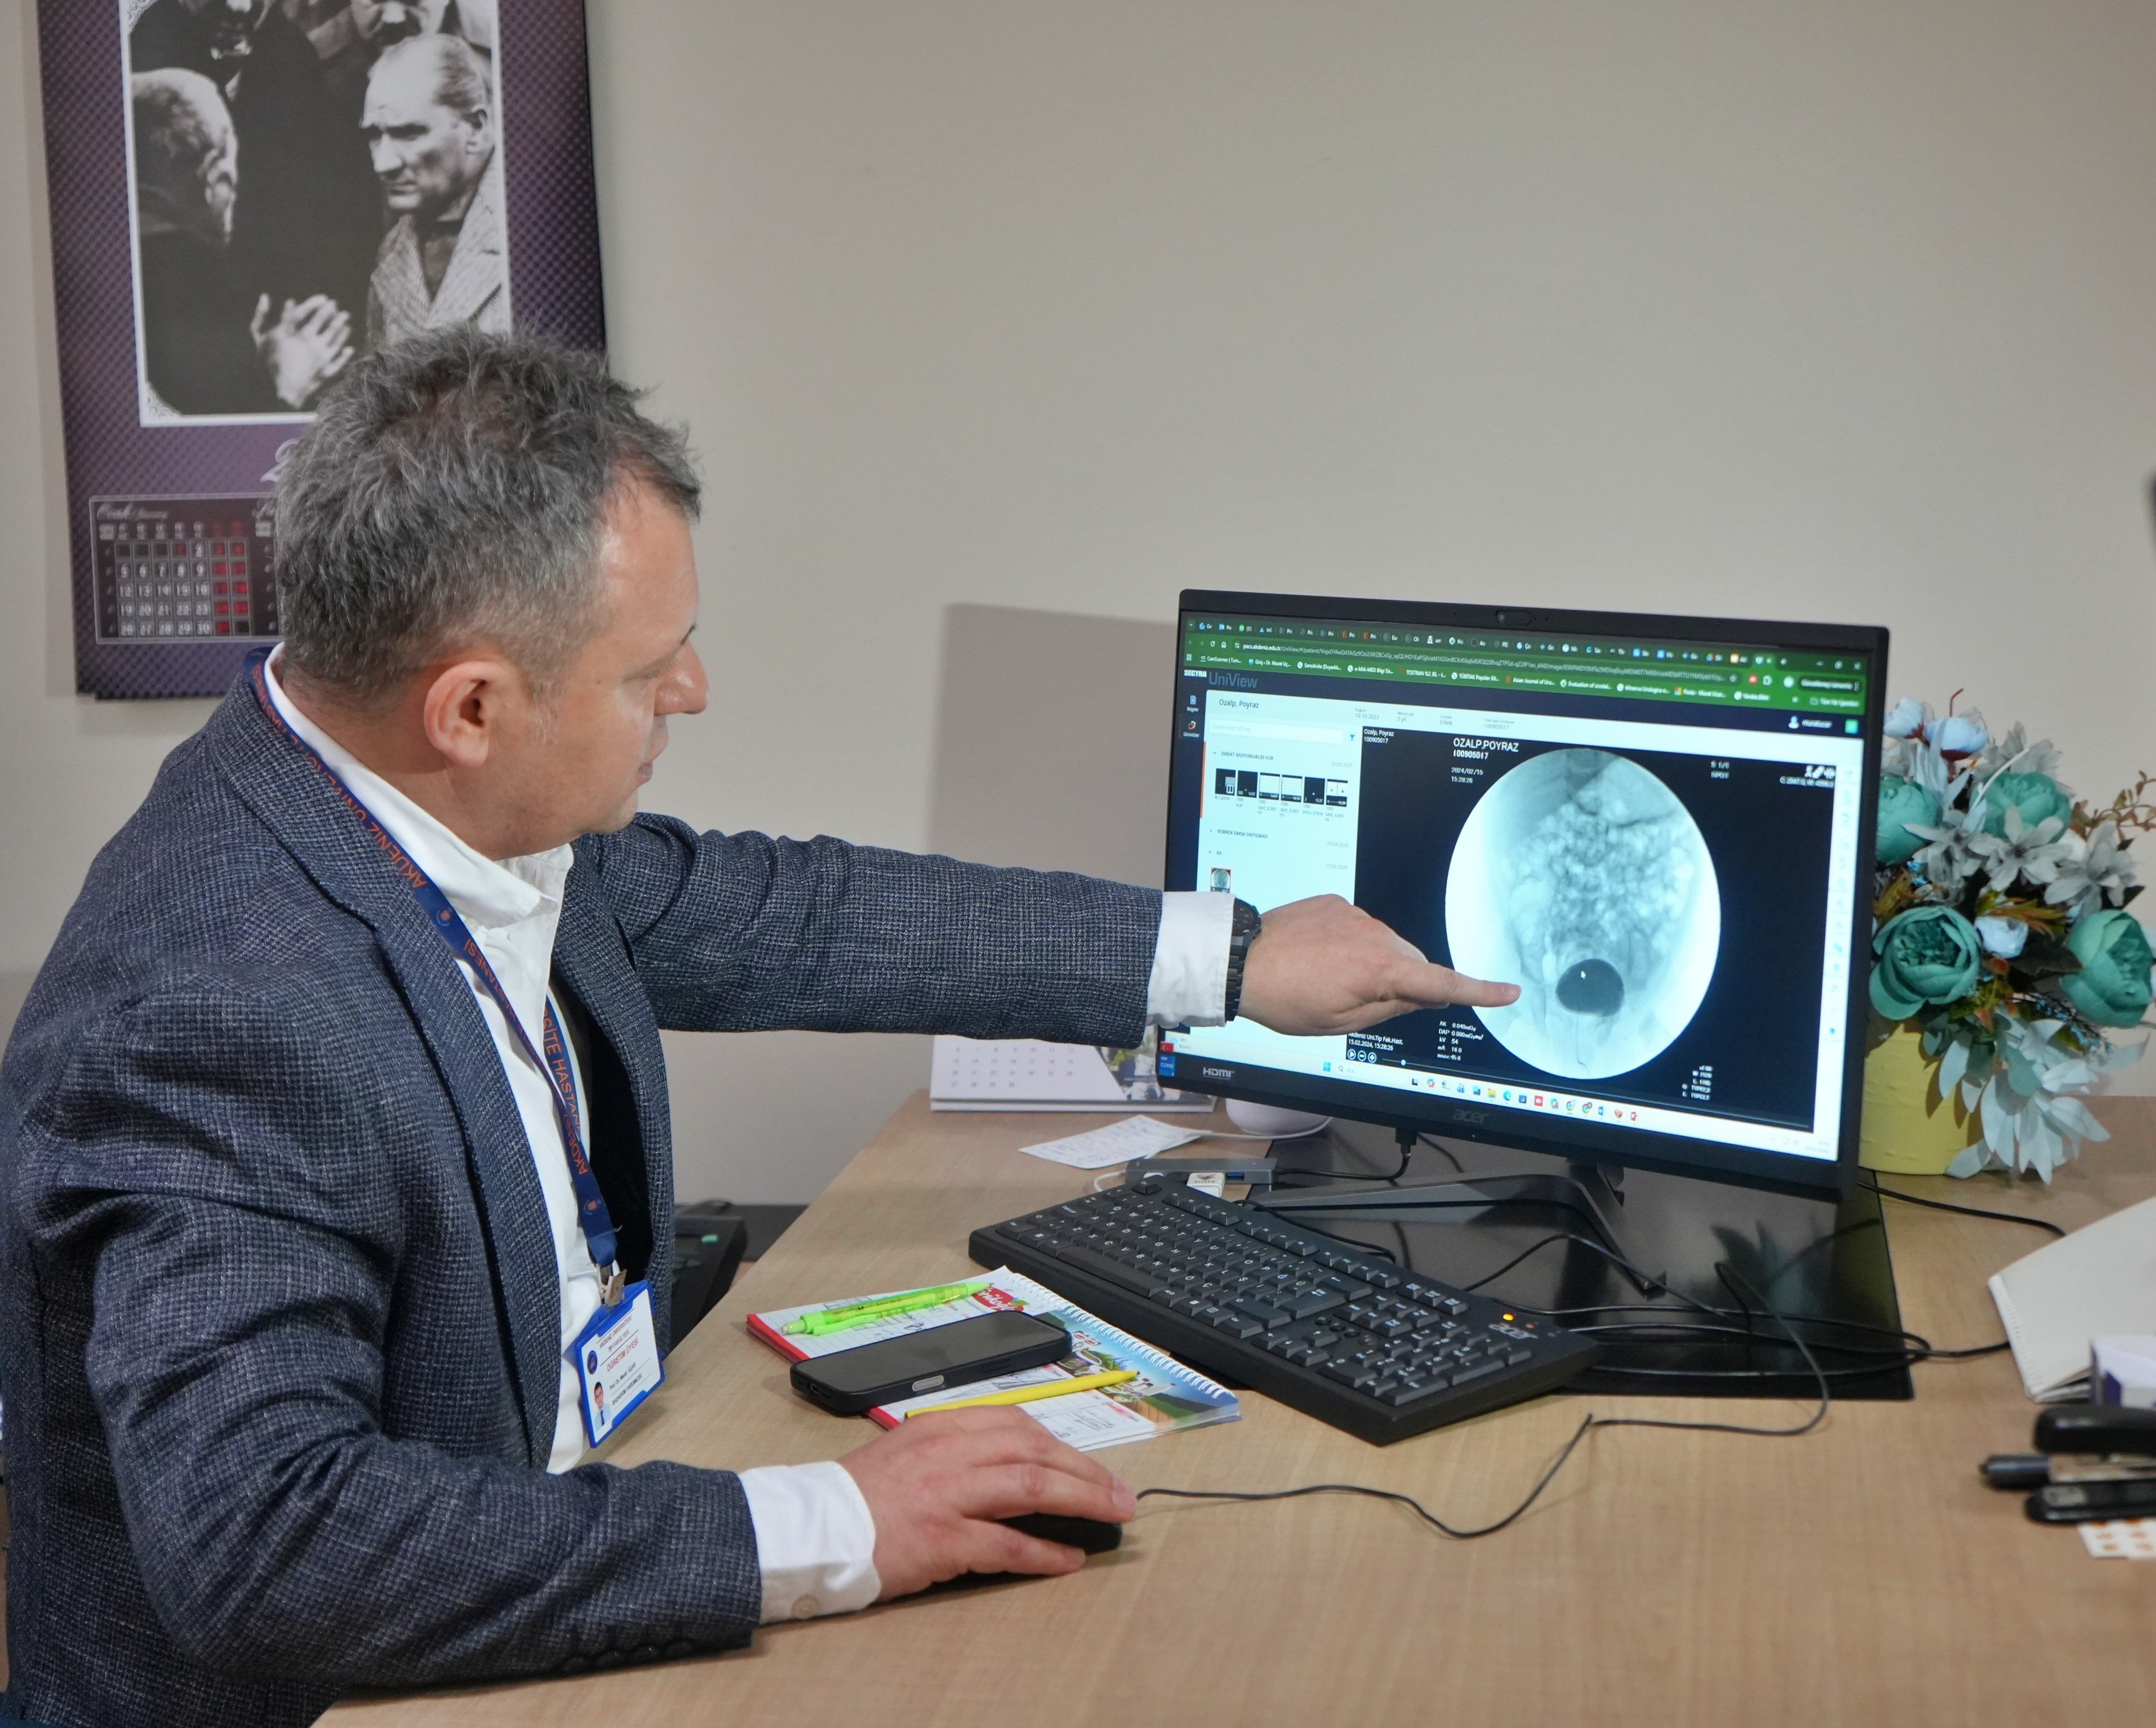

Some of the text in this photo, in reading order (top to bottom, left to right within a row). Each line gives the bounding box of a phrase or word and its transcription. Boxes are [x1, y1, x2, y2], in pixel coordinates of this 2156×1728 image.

[1184, 669, 1207, 678] SECTRA
[1208, 671, 1257, 688] UniView
[1239, 700, 1259, 709] Poyraz
[1363, 736, 1389, 744] 100905017
[1453, 750, 1489, 760] 100905017
[1451, 767, 1483, 776] 2024/02/15
[1203, 1067, 1232, 1078] HDMI
[1451, 1109, 1490, 1124] acer
